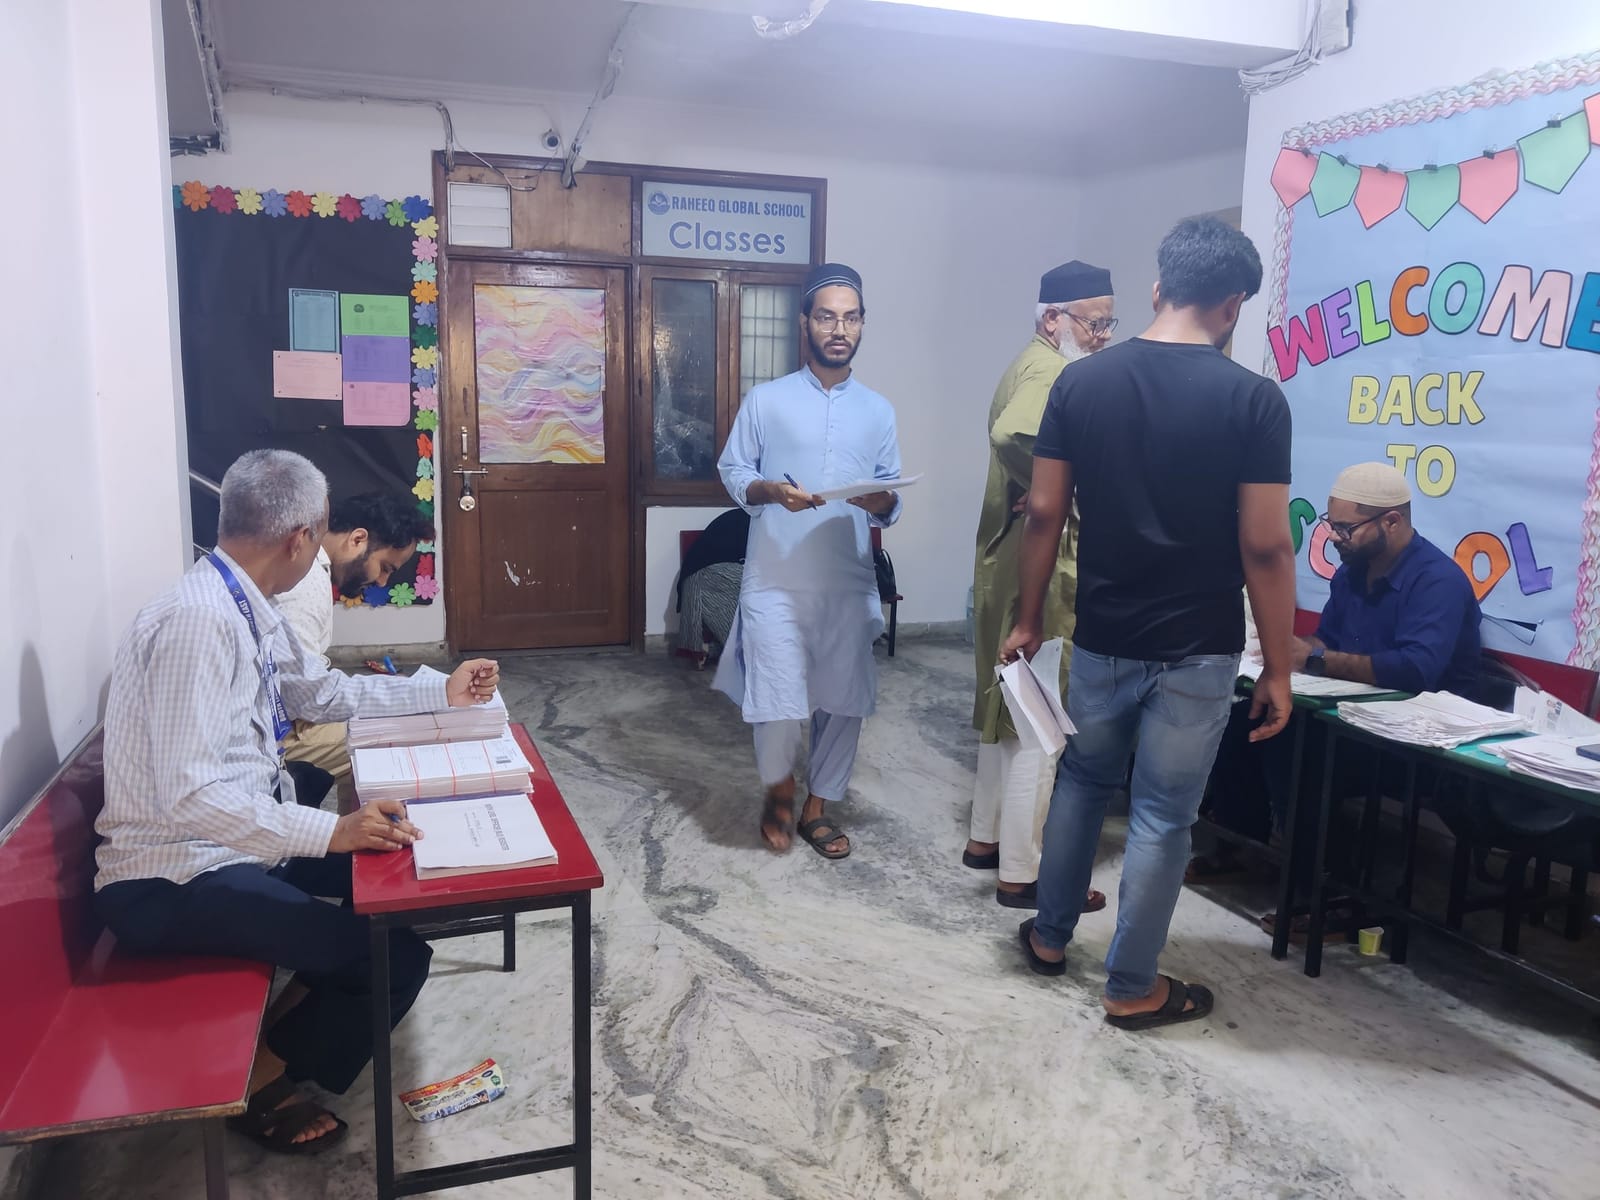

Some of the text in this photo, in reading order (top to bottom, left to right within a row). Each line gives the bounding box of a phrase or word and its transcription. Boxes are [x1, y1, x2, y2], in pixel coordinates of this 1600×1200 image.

[672, 196, 806, 218] RAHEEQ GLOBAL SCHOOL
[669, 221, 785, 254] Classes
[1348, 370, 1485, 426] BACK
[1386, 444, 1457, 497] TO
